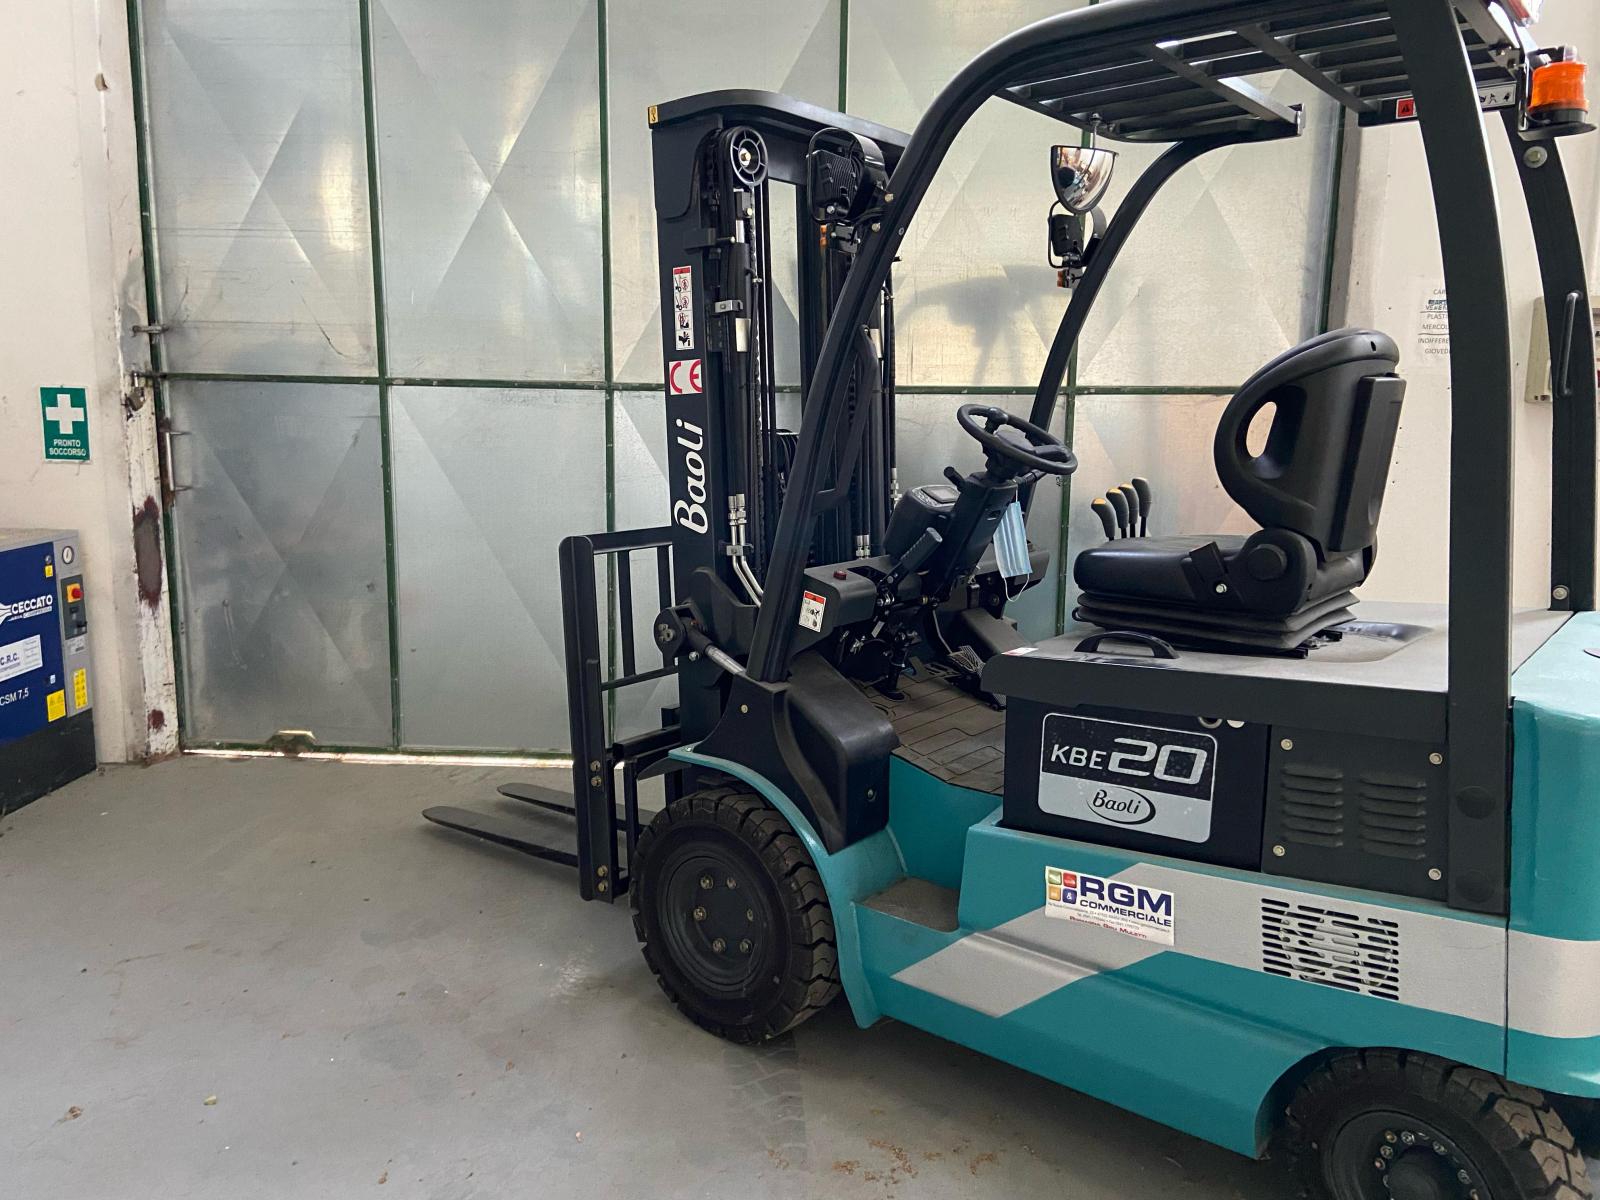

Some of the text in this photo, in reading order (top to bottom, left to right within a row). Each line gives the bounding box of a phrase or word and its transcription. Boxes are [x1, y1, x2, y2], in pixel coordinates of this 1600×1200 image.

[49, 447, 87, 457] SOCCORSO
[53, 439, 81, 447] PRONTO
[673, 418, 709, 534] Baoli
[11, 594, 53, 614] CECCATO
[1092, 789, 1142, 815] Baoli
[1079, 875, 1172, 917] RGM
[1079, 899, 1172, 927] COMMERCIALE
